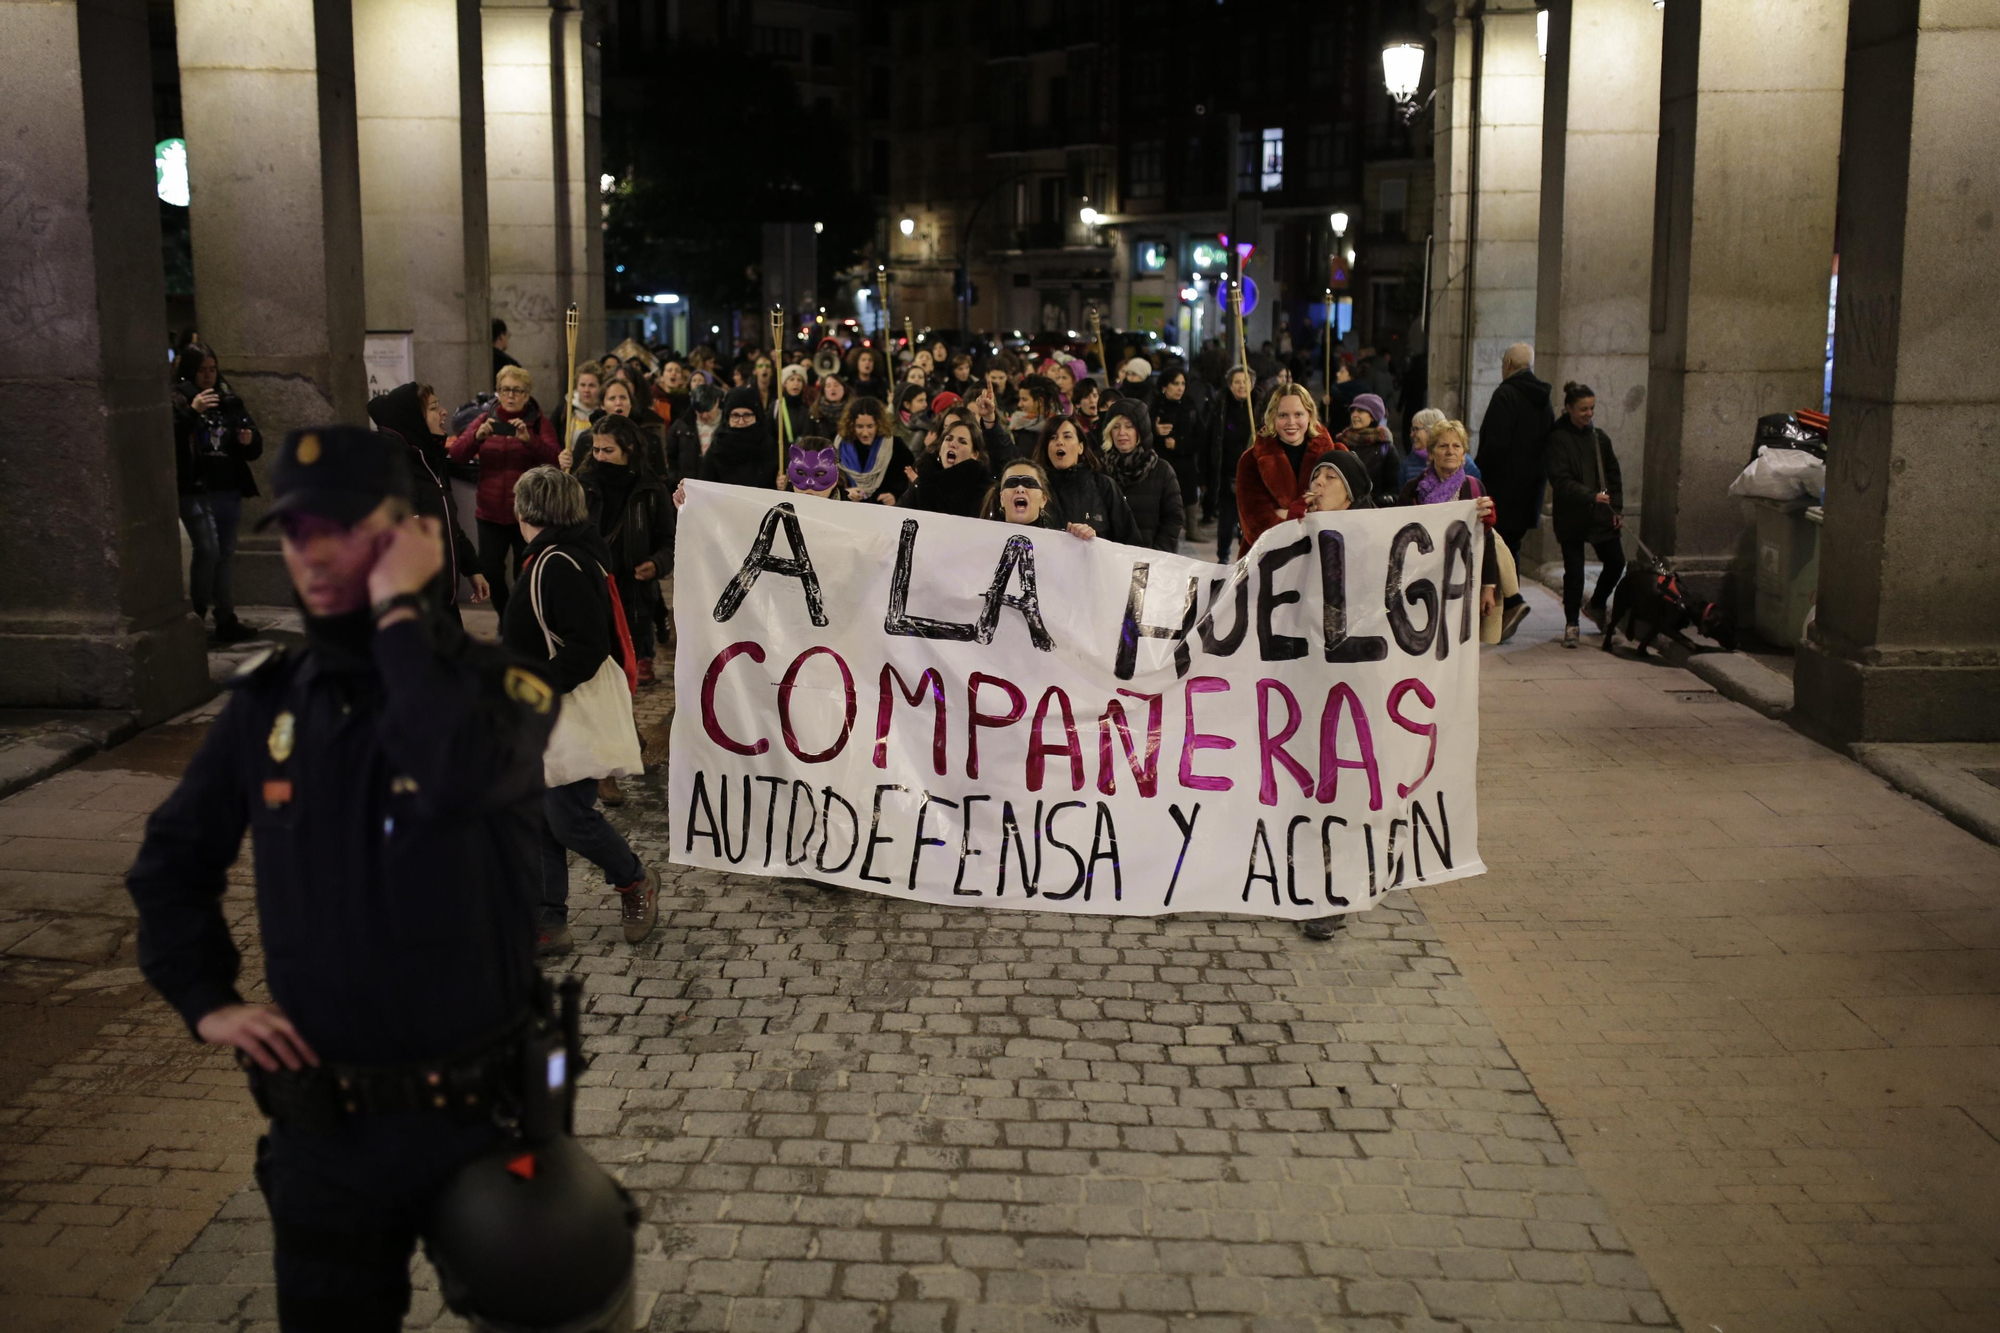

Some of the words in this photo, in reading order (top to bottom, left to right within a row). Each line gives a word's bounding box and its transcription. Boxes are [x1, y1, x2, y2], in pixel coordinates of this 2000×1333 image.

[713, 501, 830, 628] A
[884, 517, 1057, 653] LA
[1113, 519, 1476, 681] HUELGA
[700, 640, 1438, 812] COMPAÑERAS
[685, 769, 1122, 902] AUTODEFENSA
[1164, 802, 1200, 907] Y
